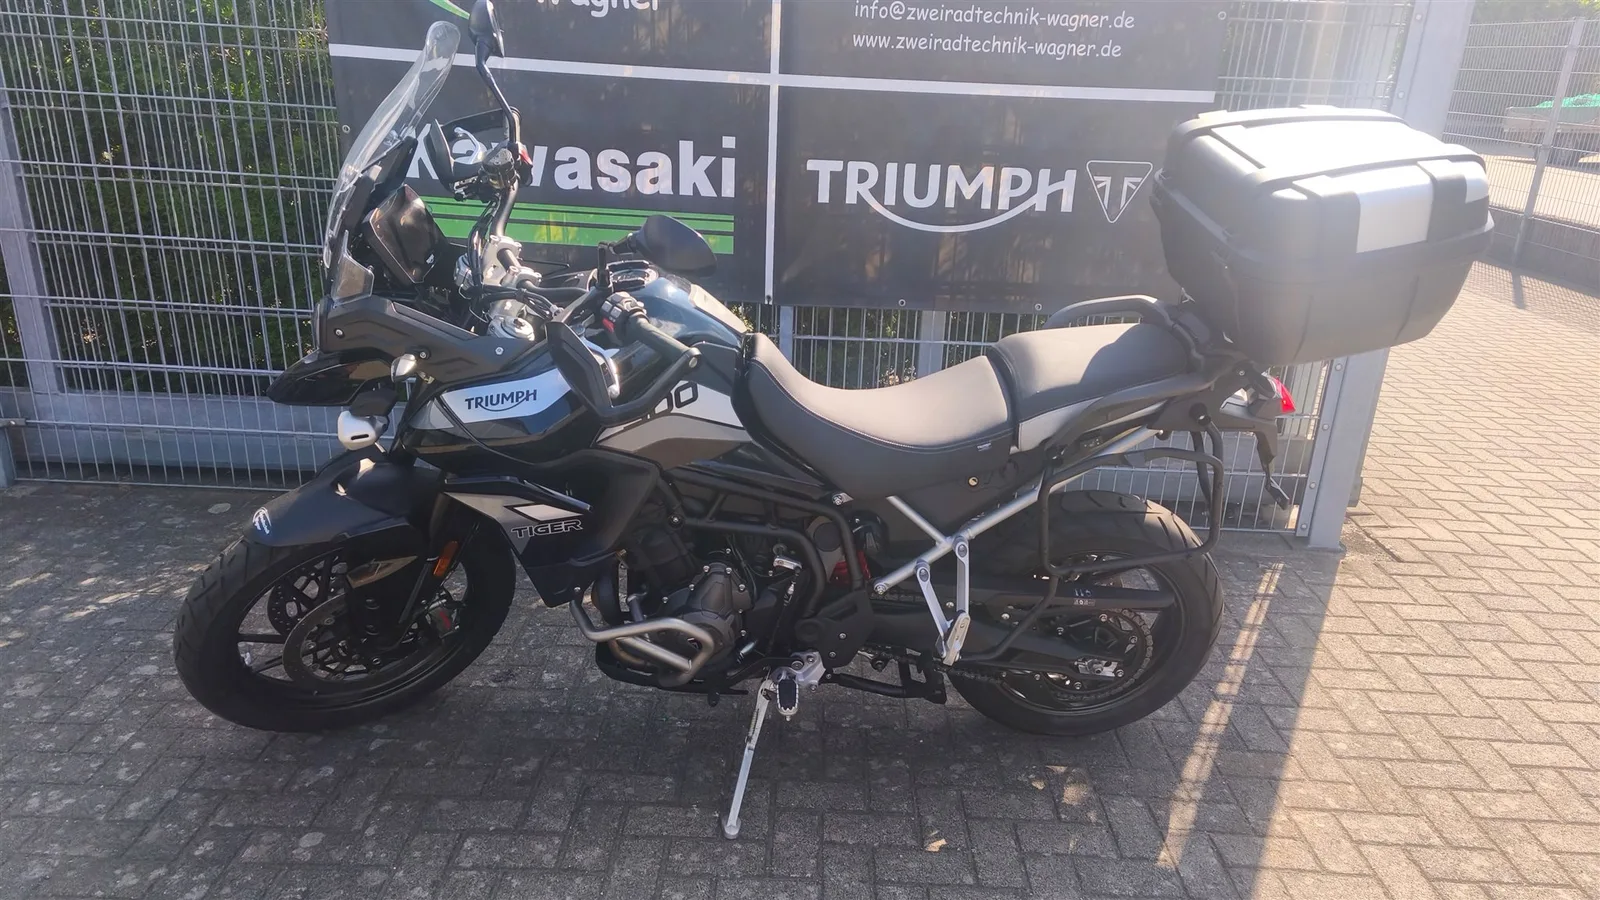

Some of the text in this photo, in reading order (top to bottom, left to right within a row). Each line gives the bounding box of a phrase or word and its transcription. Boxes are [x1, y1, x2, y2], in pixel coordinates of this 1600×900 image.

[854, 0, 1135, 32] info@zweiradtechnik-wagner.de
[852, 32, 1122, 61] www.zweiradtechnik-wagner.de
[806, 158, 1078, 233] TRIUMPH
[464, 388, 538, 413] TRIUMPH
[511, 519, 584, 539] TIGER
